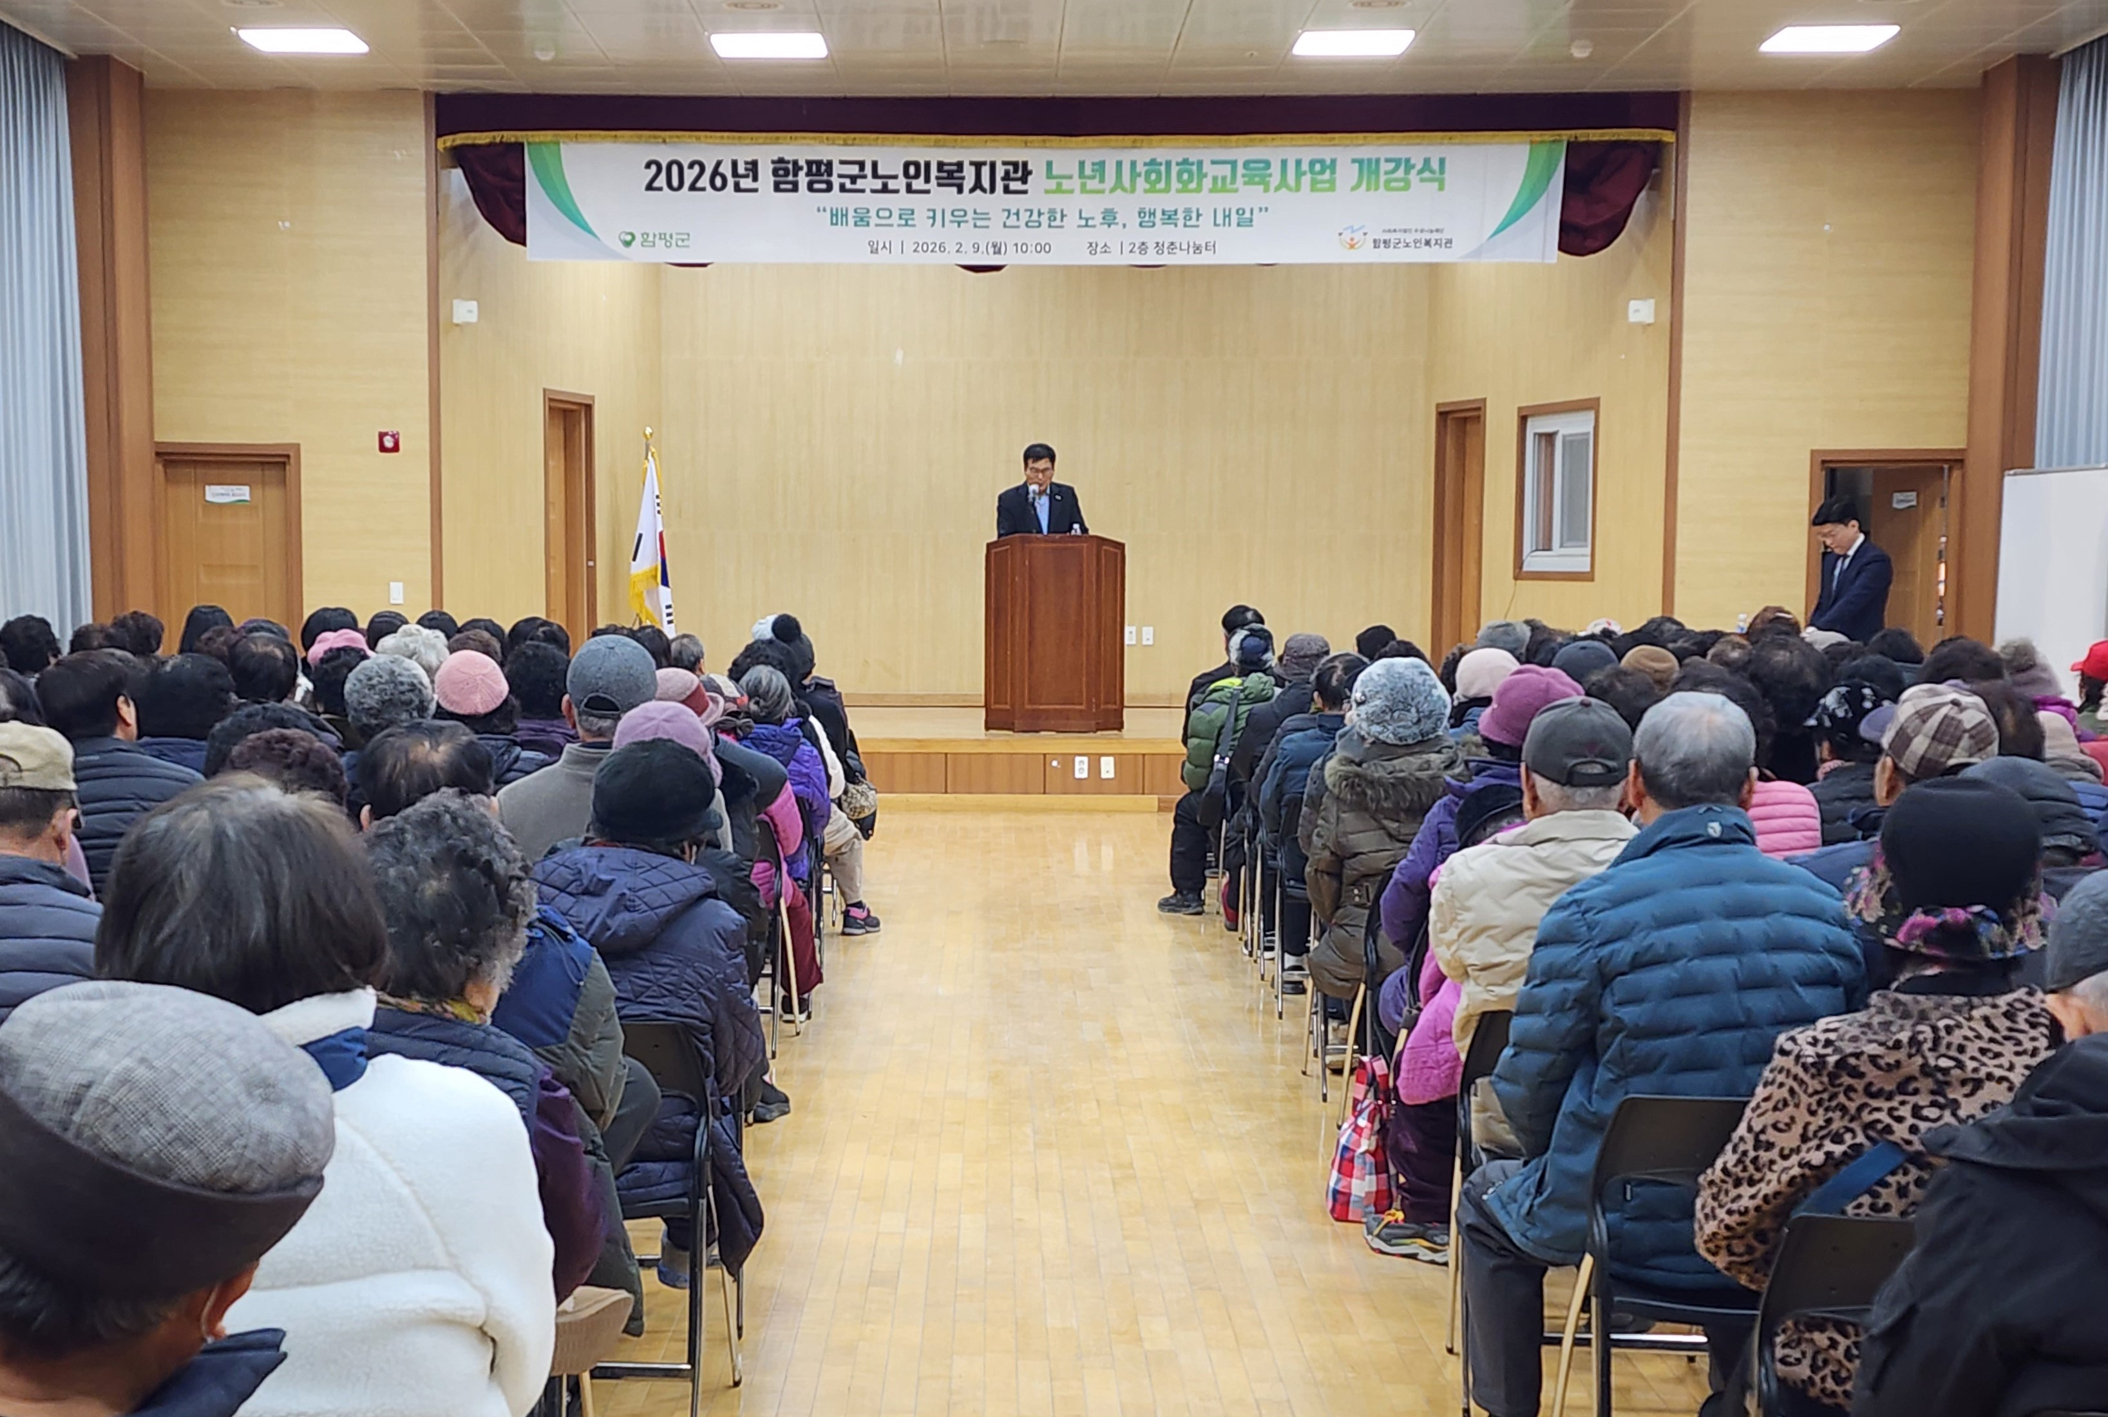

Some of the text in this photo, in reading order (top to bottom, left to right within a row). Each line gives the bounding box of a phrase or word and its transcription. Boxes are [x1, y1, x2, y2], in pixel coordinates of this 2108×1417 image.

[643, 156, 1447, 195] 2026년 함평군노인복지관 노년사회화교육사업 개강식
[926, 208, 992, 229] 키우는
[1001, 207, 1068, 229] 건강한
[1077, 207, 1127, 230] 노후,
[1137, 206, 1204, 229] 행복한
[640, 231, 690, 249] 함평군
[867, 240, 892, 255] 일시
[912, 241, 951, 255] 2026.
[1012, 241, 1052, 255] 10:00
[1087, 241, 1112, 256] 장소
[1128, 241, 1149, 256] 2층
[1372, 237, 1454, 250] 함평군노인복지관
